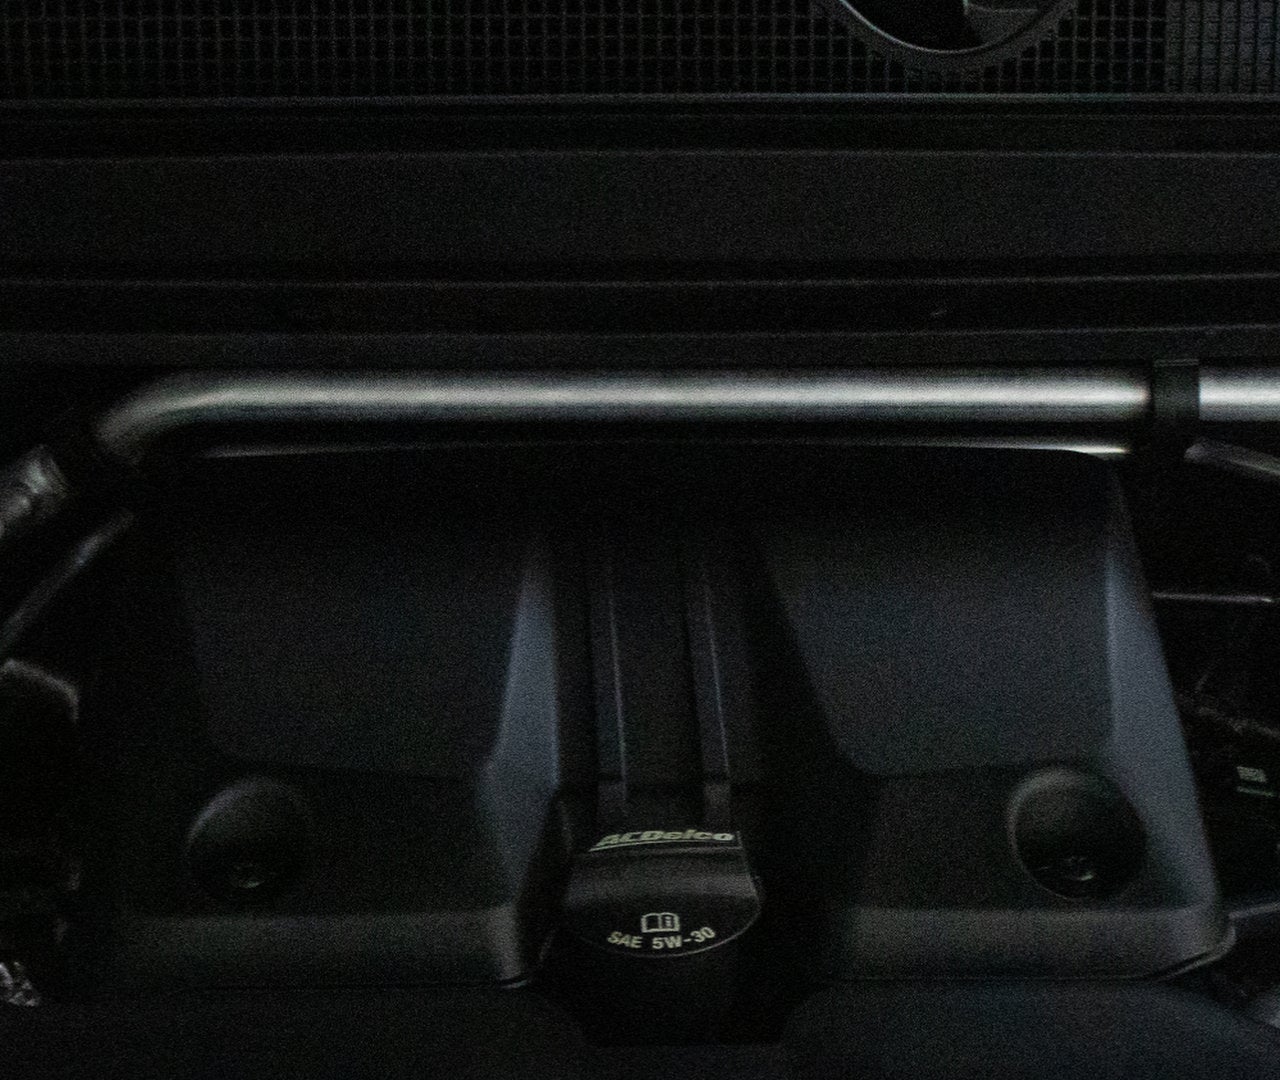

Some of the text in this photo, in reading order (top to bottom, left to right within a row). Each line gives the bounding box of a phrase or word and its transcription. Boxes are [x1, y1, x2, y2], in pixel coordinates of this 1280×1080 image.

[595, 829, 735, 848] ACDelco
[606, 926, 717, 951] SAE 5W-30
